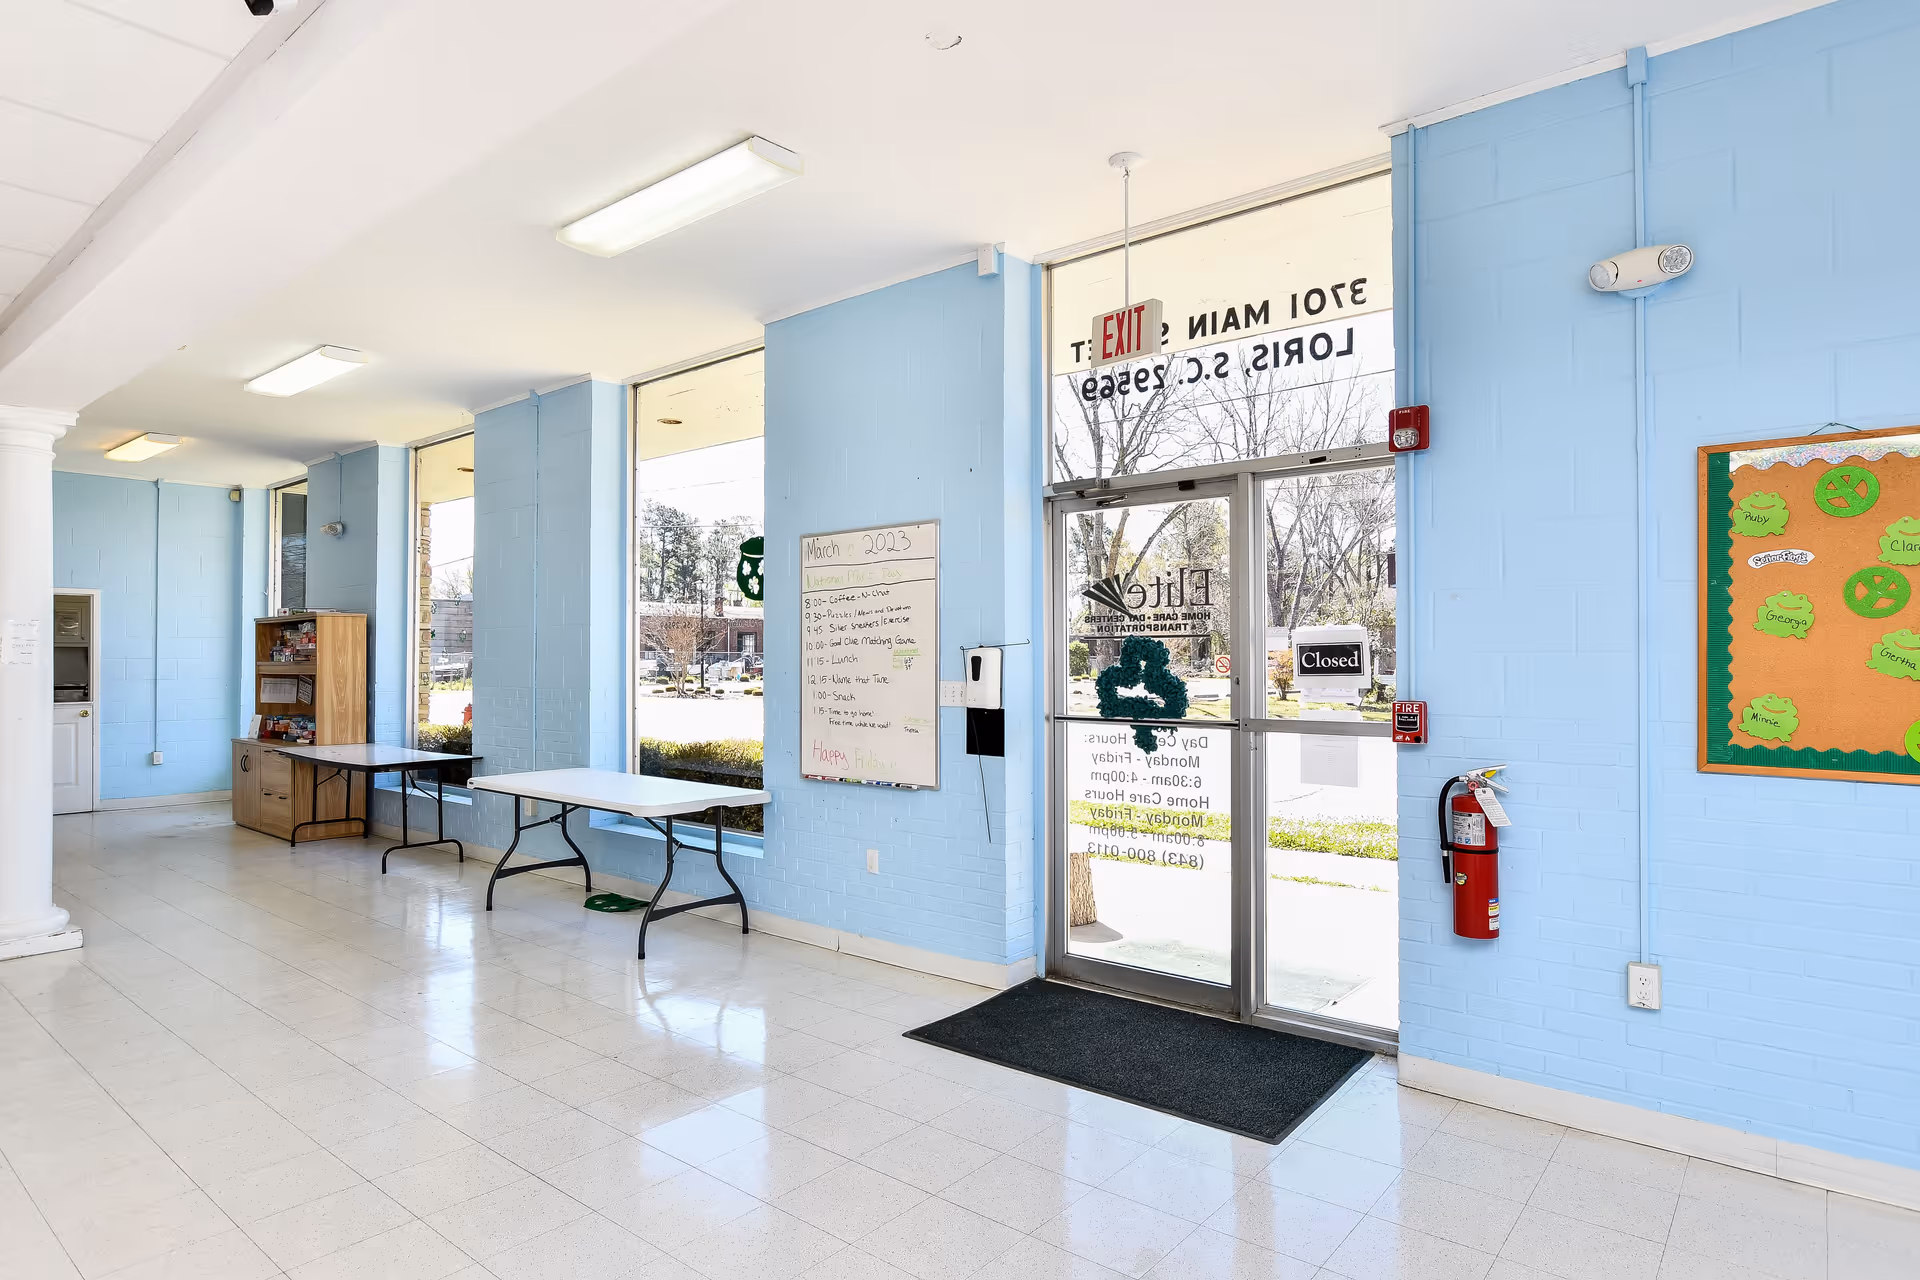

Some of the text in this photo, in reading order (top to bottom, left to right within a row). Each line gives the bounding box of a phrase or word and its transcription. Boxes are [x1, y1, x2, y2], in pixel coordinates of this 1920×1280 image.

[1102, 305, 1145, 360] EXIT
[1744, 511, 1770, 525] Ruby
[807, 538, 840, 562] March
[862, 531, 912, 555] 2023
[1765, 610, 1808, 627] Georgia
[831, 653, 858, 665] Lunch
[1301, 651, 1360, 668] Closed
[1880, 647, 1917, 670] Gertha
[832, 691, 856, 701] Snack
[1395, 703, 1420, 713] FIRE
[1751, 711, 1781, 728] Minnie
[813, 739, 850, 770] Happy
